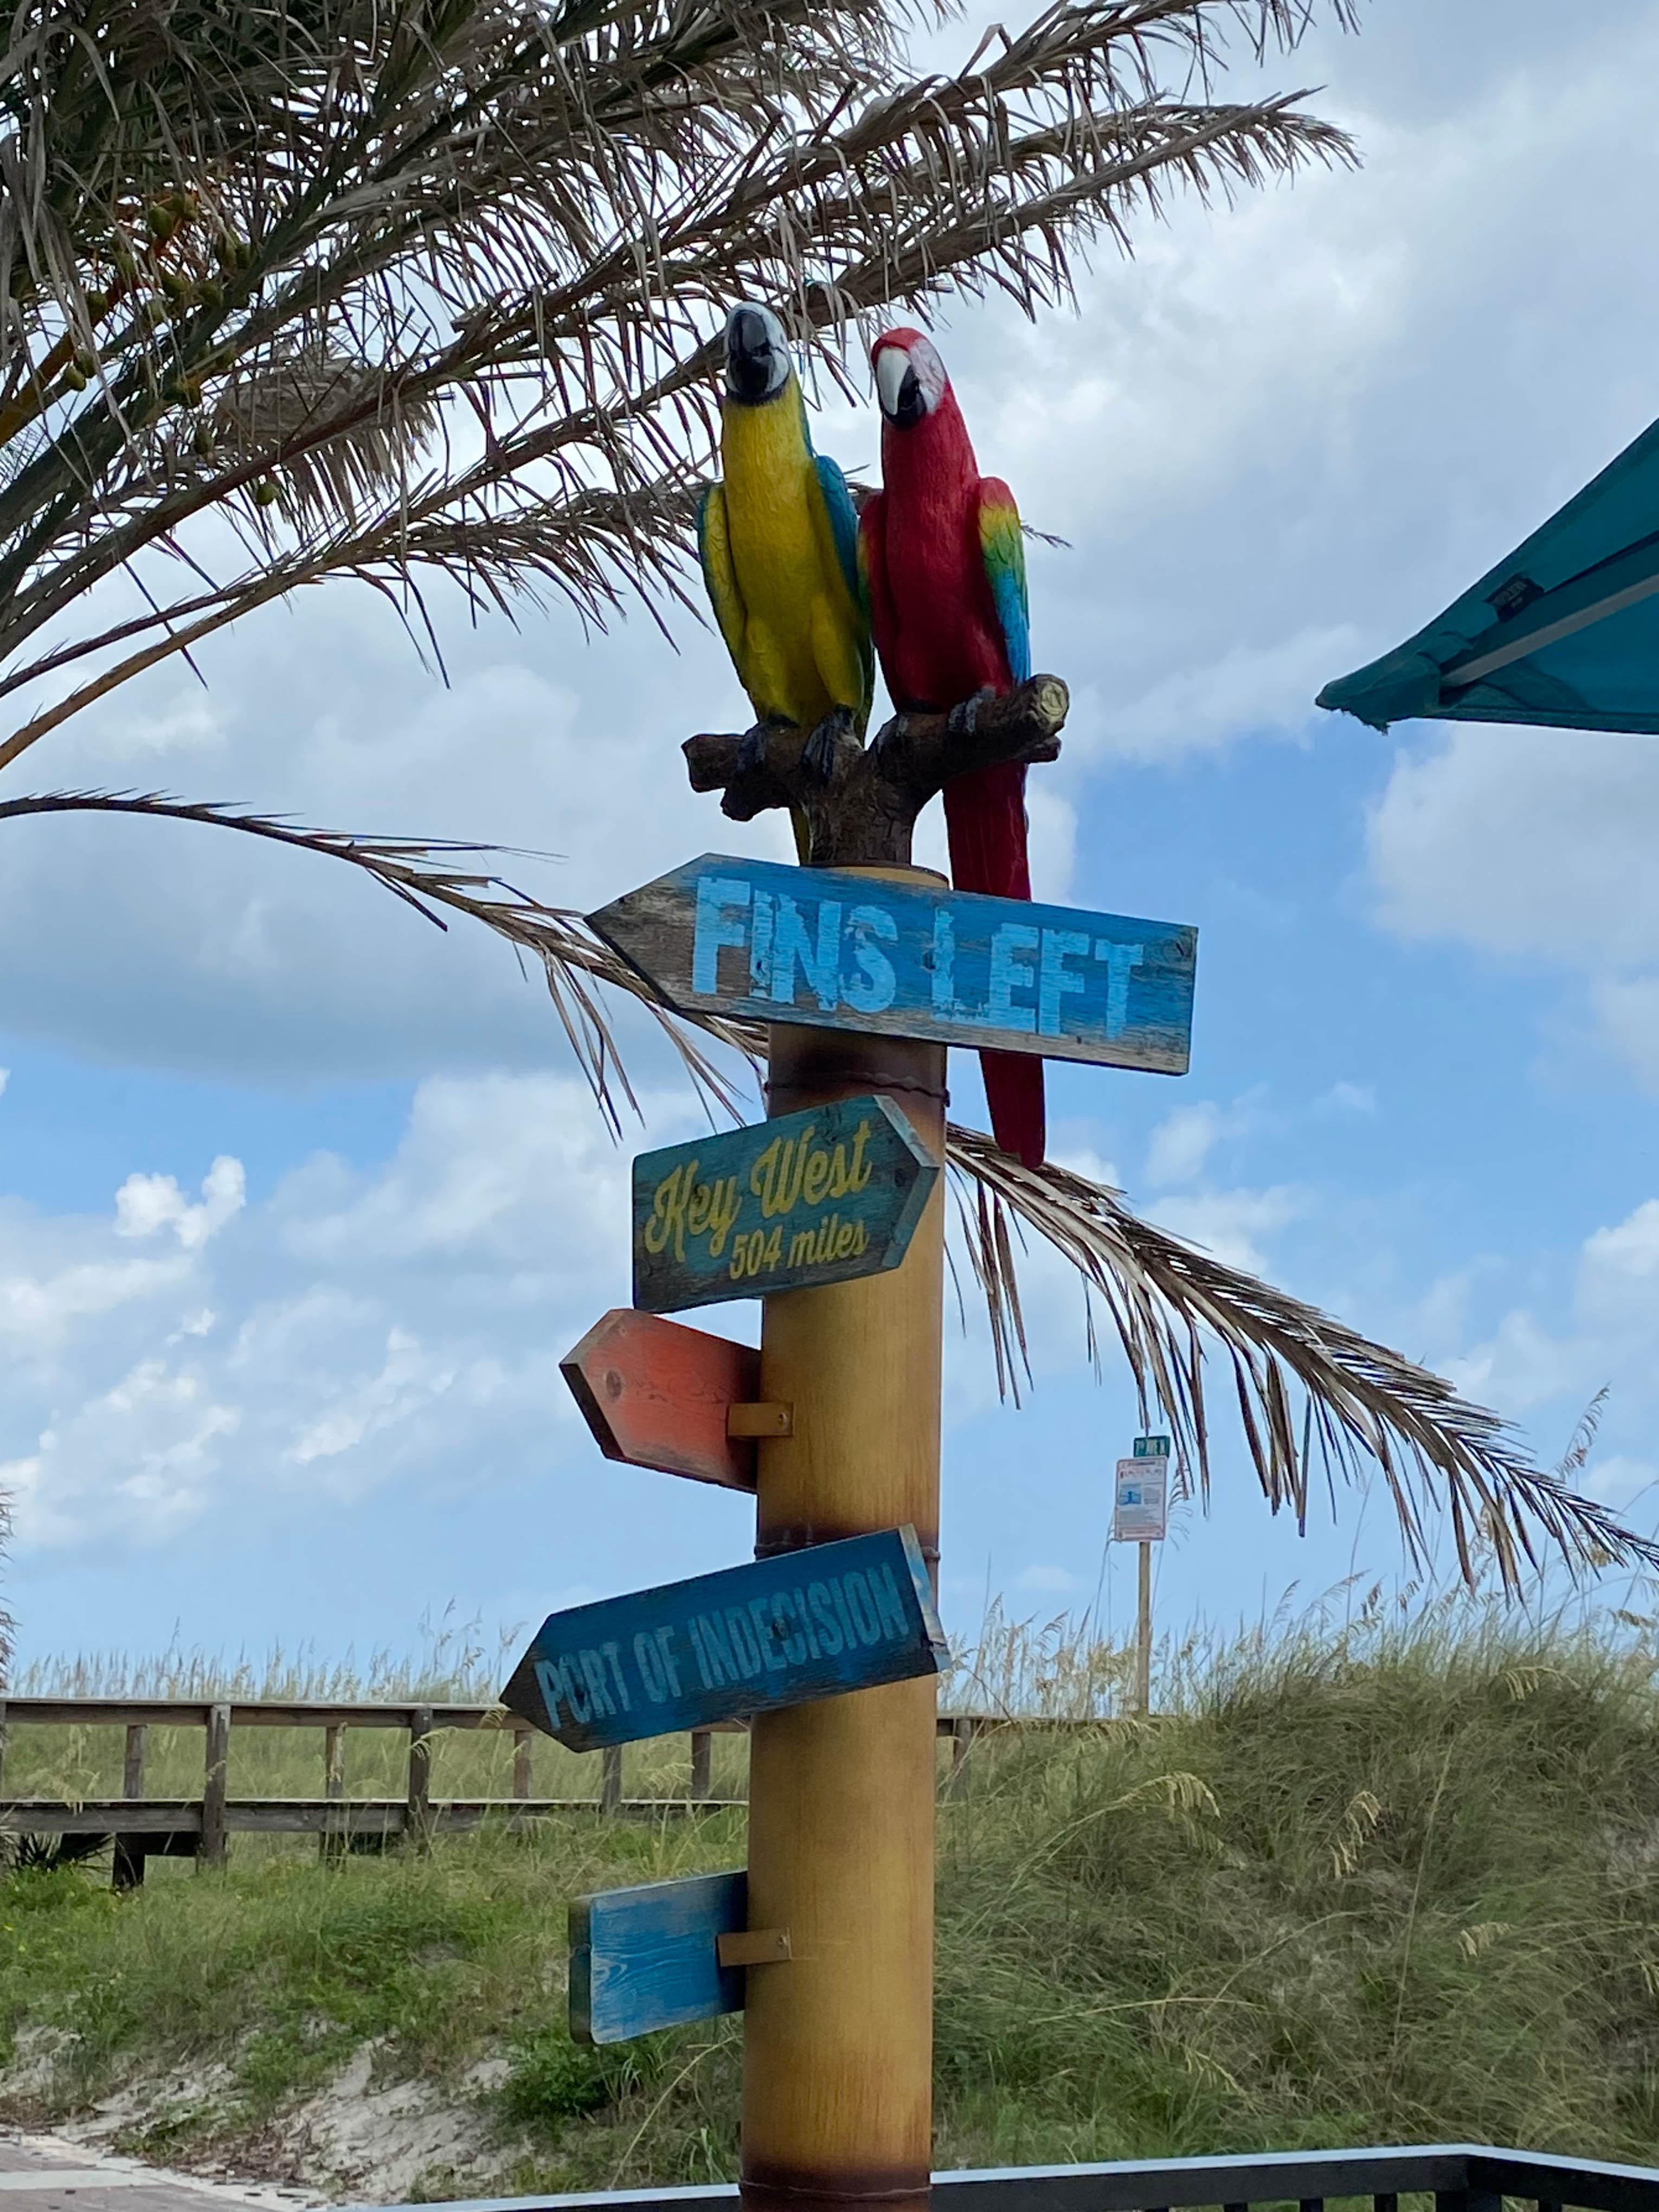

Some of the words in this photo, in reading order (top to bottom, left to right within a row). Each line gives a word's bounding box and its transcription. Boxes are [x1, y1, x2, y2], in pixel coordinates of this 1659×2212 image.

[691, 876, 899, 1014] FINS
[931, 908, 1143, 1039] LEFT
[645, 1159, 742, 1262] Key
[751, 1121, 872, 1218] West
[730, 1225, 783, 1280] 504
[787, 1212, 869, 1269] miles
[535, 1641, 631, 1731] PORT
[633, 1625, 683, 1703] OF
[689, 1562, 910, 1690] INDECISION
